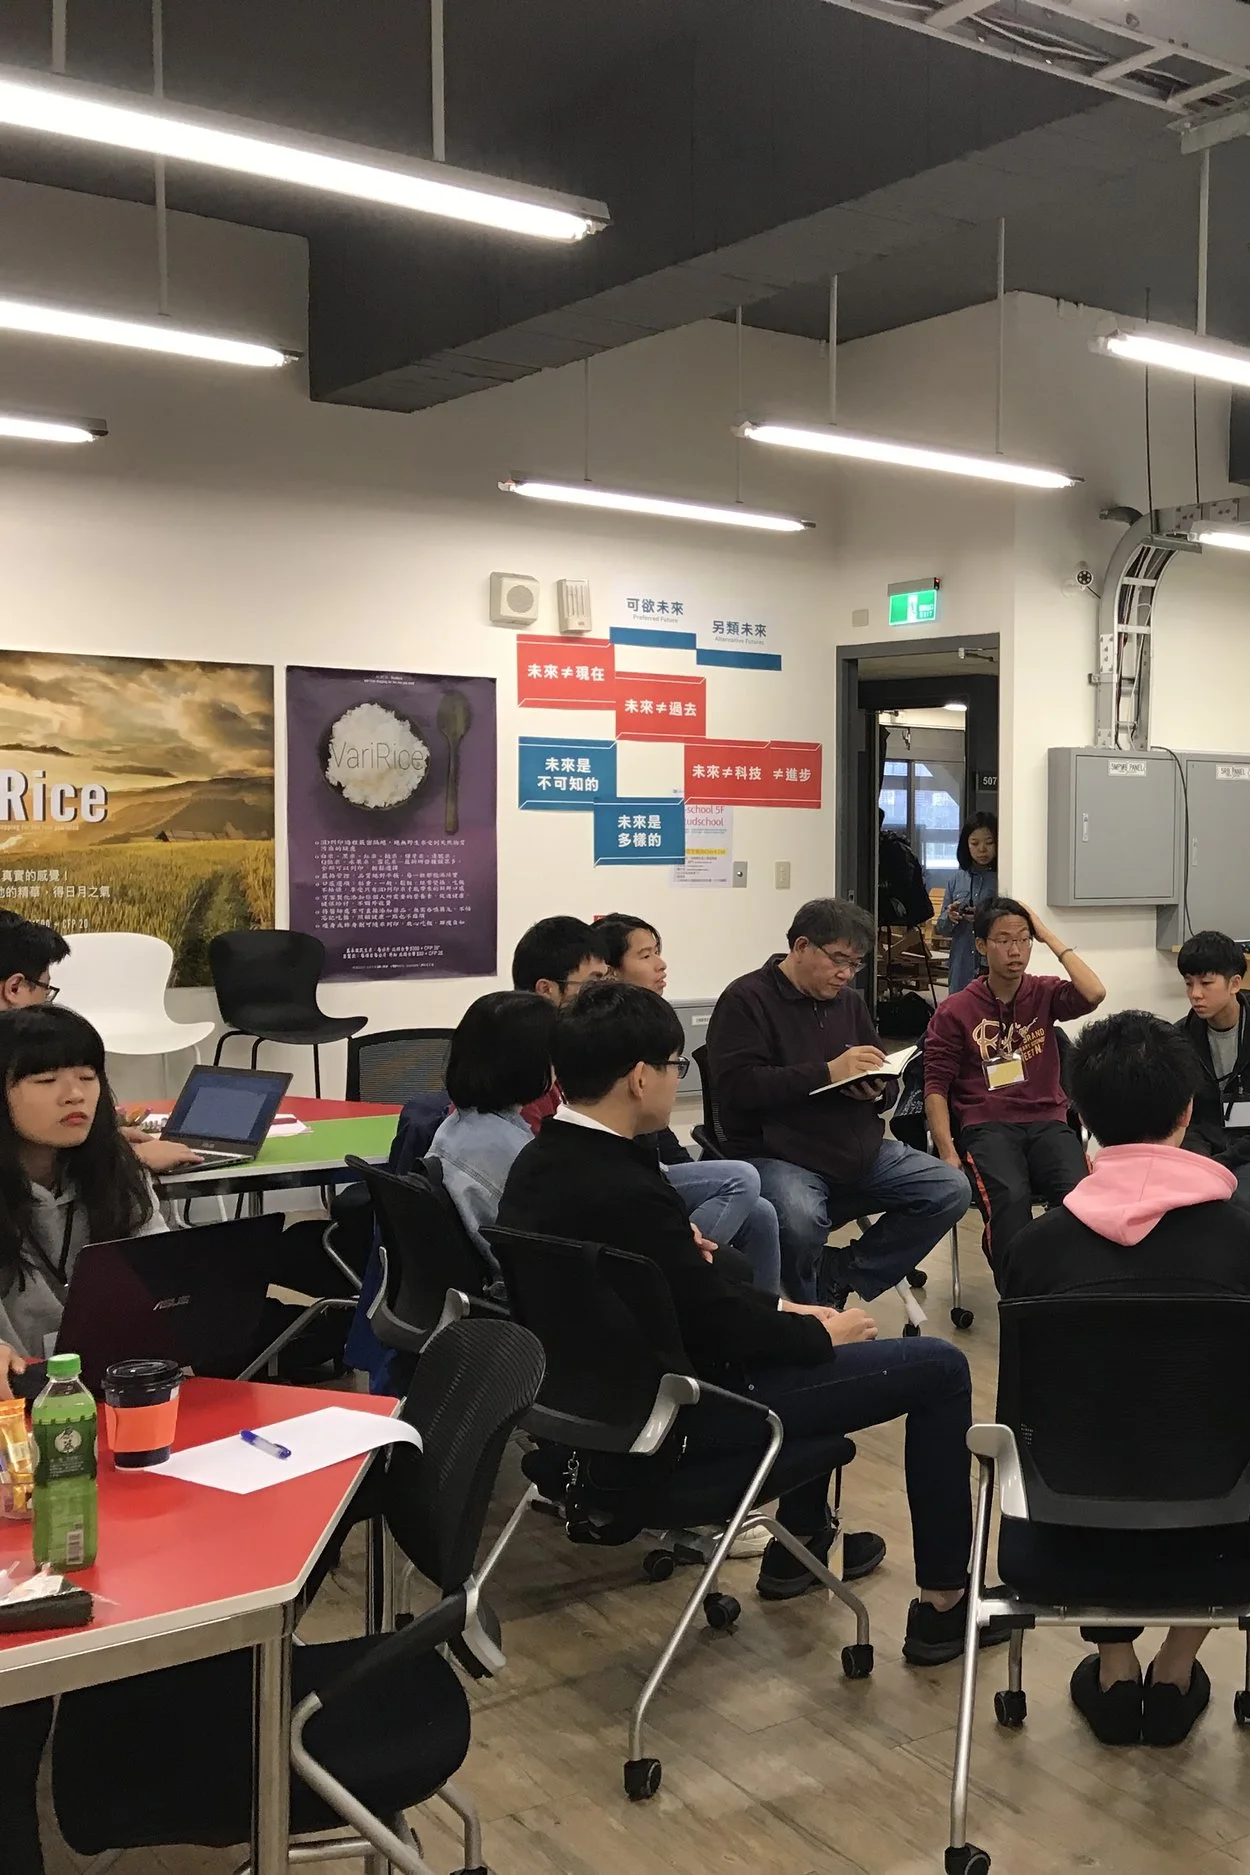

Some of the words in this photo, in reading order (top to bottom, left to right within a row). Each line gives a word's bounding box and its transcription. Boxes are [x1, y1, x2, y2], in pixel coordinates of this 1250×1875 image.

[626, 597, 684, 616] 可欲未來
[633, 614, 660, 623] Preferred
[712, 620, 767, 638] 另類未來
[527, 663, 605, 682] 未來≠現在
[624, 699, 697, 717] 未來≠過去
[330, 741, 424, 771] VariRice
[545, 757, 591, 773] 未來是
[692, 764, 762, 781] 未來≠科技
[537, 776, 600, 792] 不可知的
[982, 776, 998, 786] 507
[617, 814, 662, 830] 未來是
[683, 817, 724, 827] udschool
[617, 832, 662, 848] 多樣的
